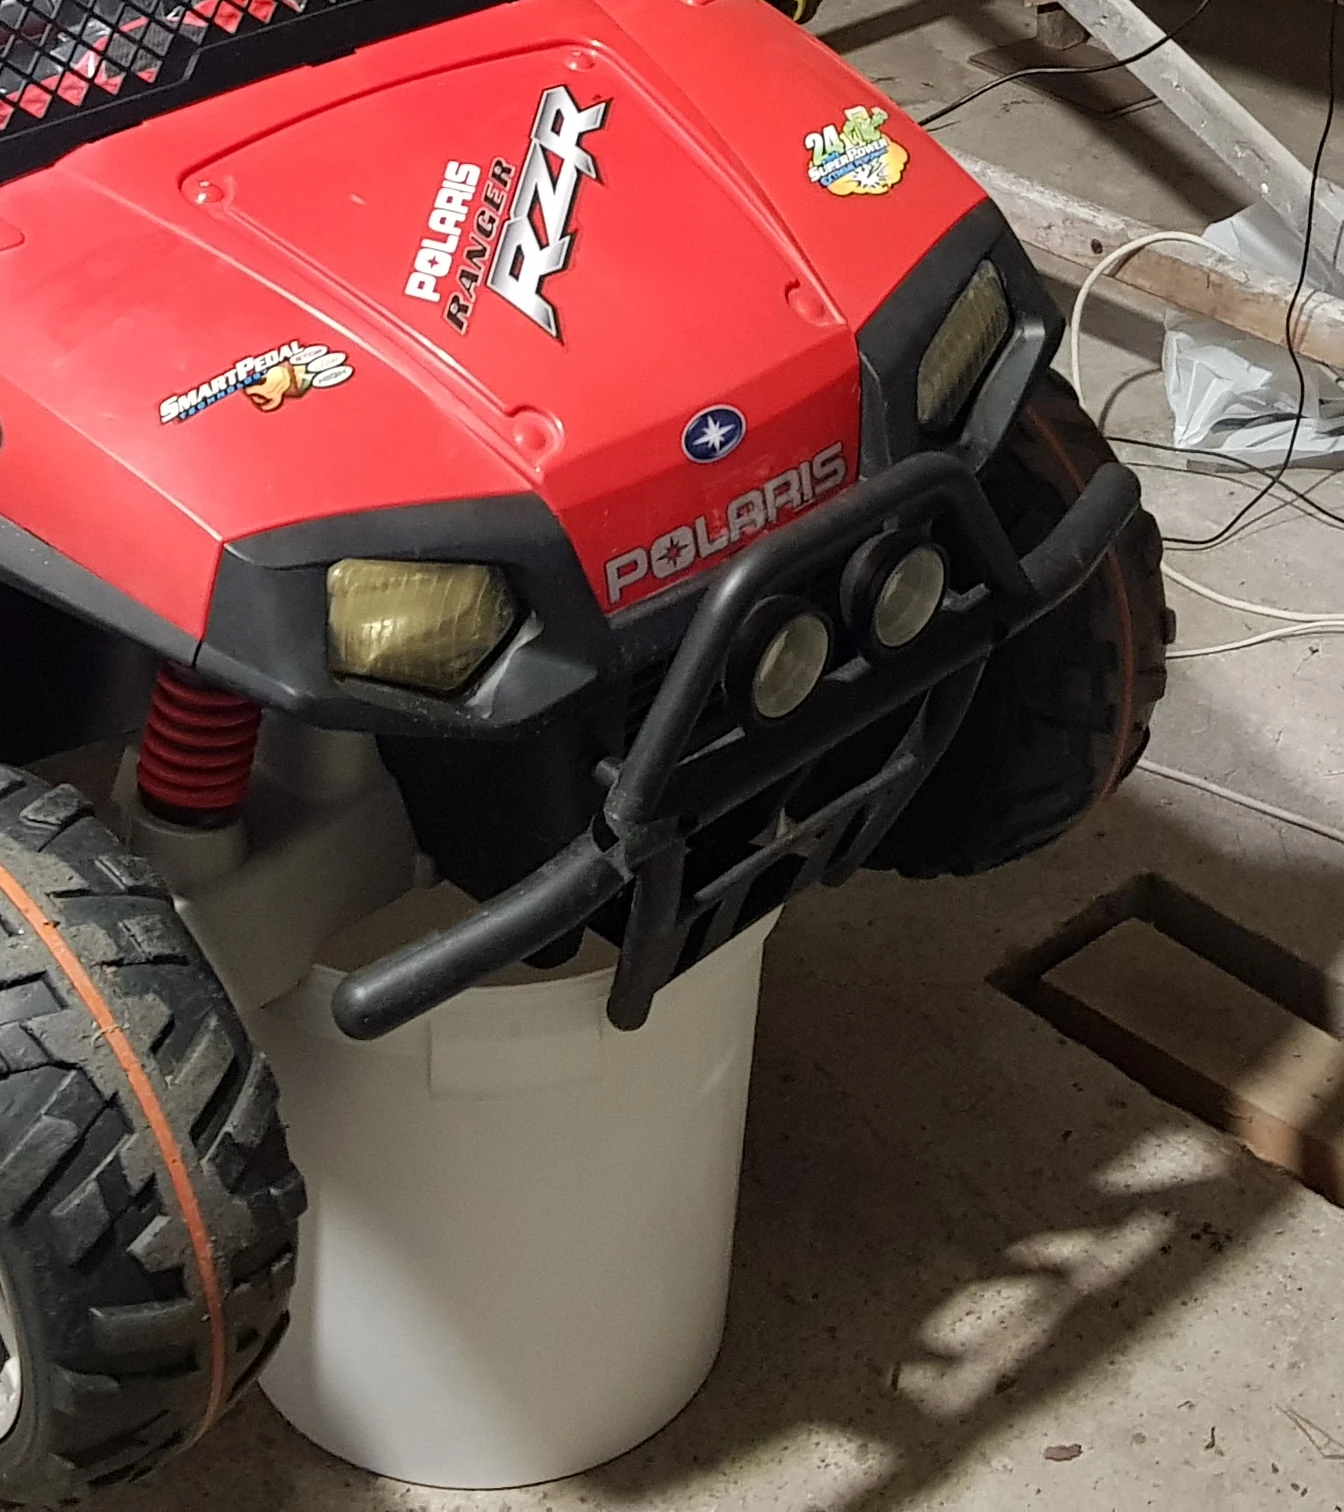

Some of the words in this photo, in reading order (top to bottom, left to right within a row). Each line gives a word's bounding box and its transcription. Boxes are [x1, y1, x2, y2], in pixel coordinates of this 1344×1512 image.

[486, 84, 613, 346] RZR
[805, 125, 844, 166] 24
[405, 160, 481, 302] POLARIS
[443, 157, 516, 336] RANGER
[605, 441, 847, 605] POLARIS
